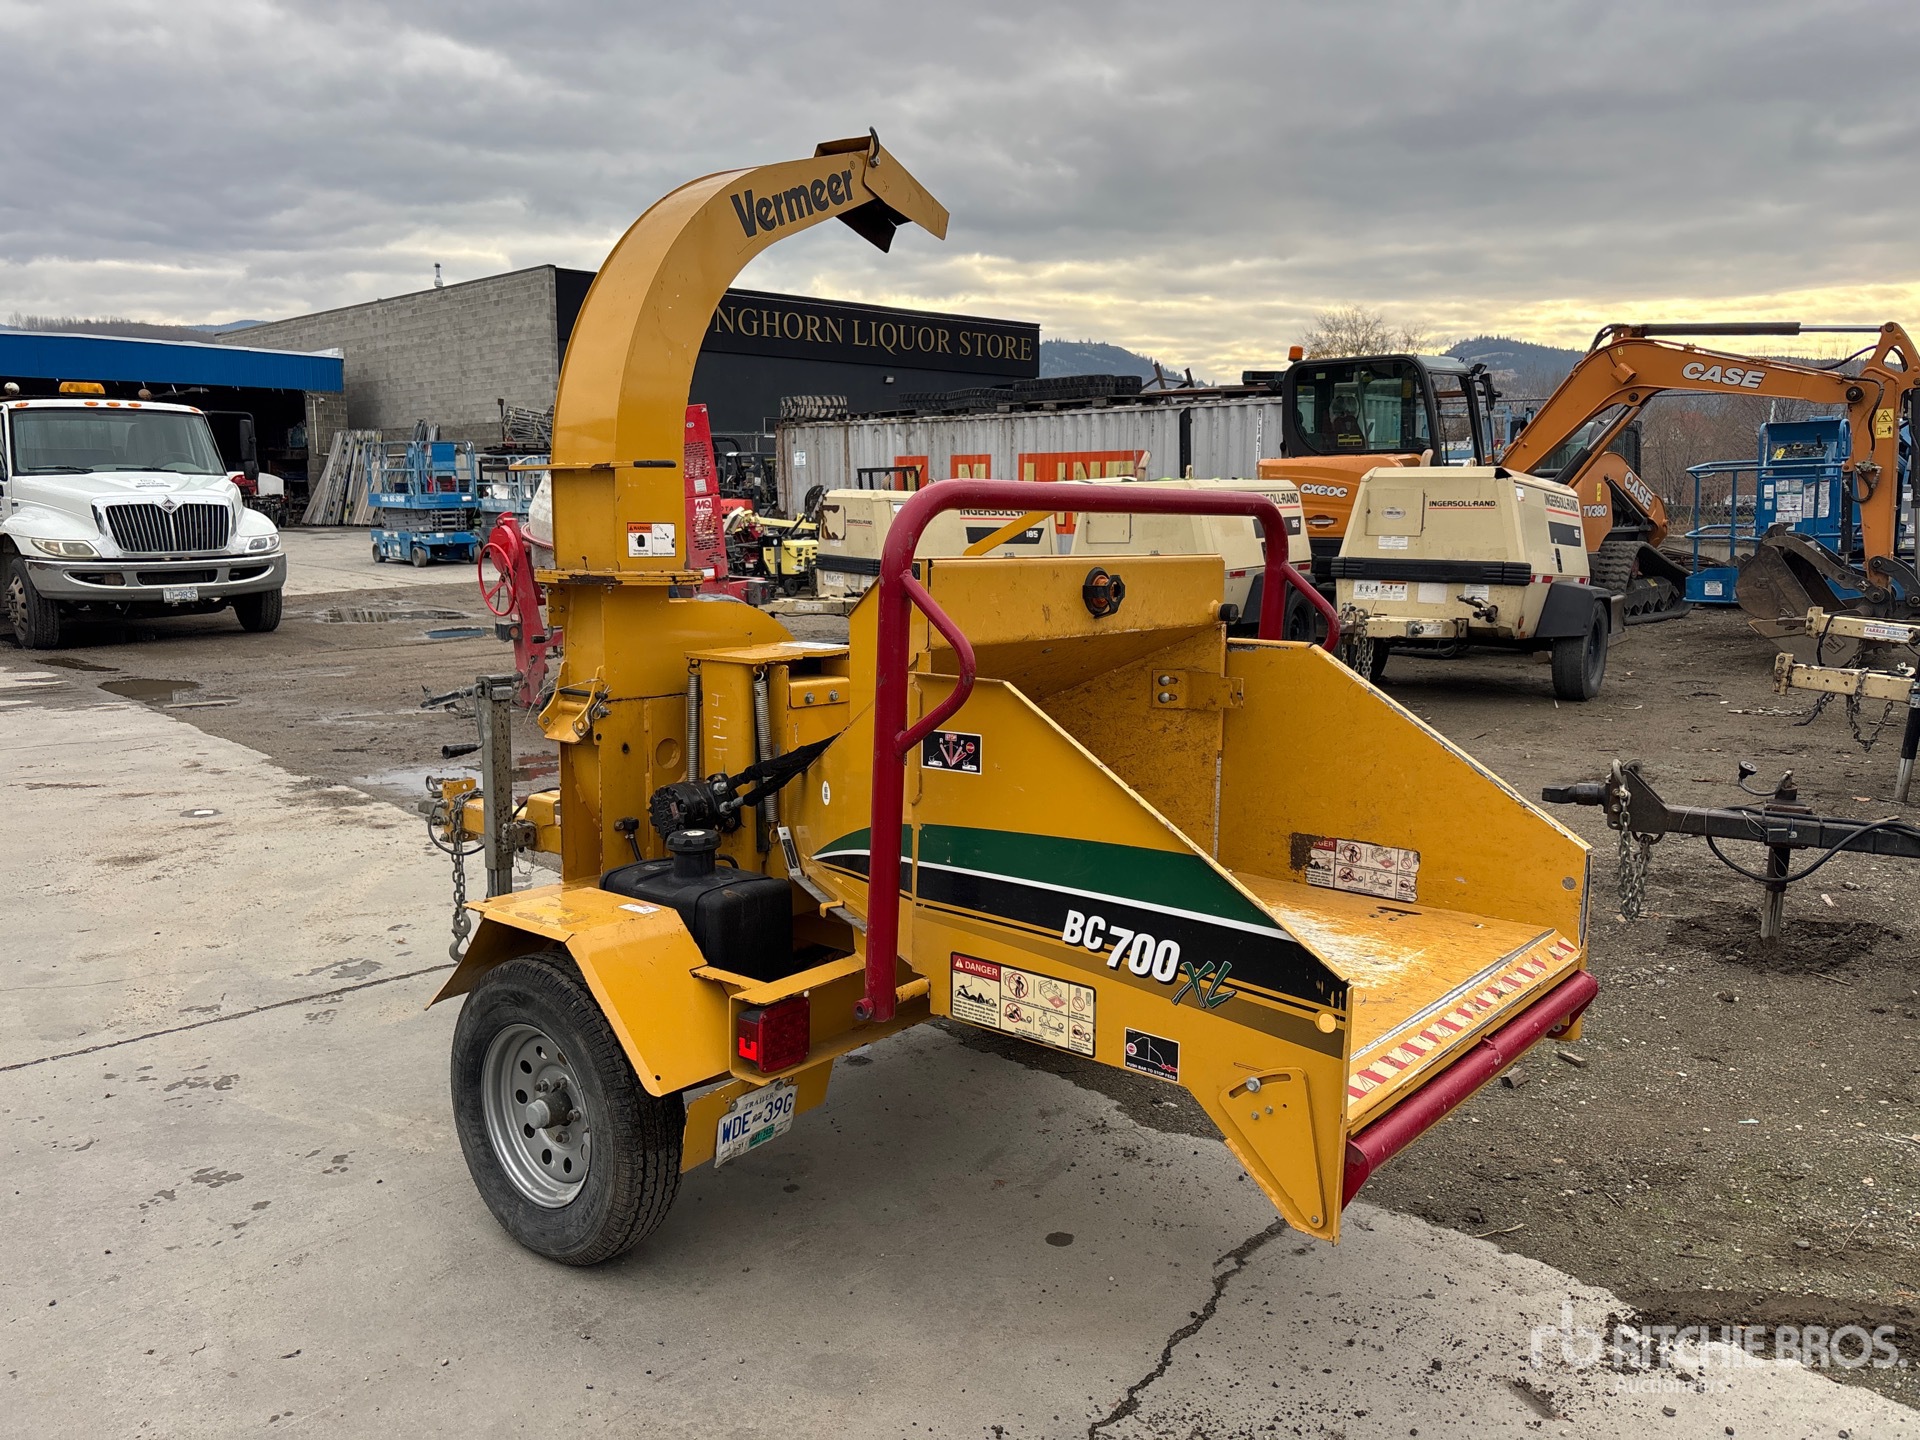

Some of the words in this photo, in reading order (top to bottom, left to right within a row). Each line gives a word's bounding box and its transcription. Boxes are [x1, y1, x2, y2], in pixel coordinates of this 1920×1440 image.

[730, 169, 854, 238] Vermeer
[714, 306, 844, 343] NGHORN
[853, 319, 952, 355] LIQUOR
[959, 331, 1032, 361] STORE
[1682, 362, 1766, 389] CASE
[1624, 471, 1653, 510] CASE
[1583, 505, 1607, 518] TV380
[1026, 530, 1039, 538] 185
[965, 961, 998, 976] DANGER
[1171, 960, 1237, 1009] XL
[744, 1092, 774, 1110] TRAILER
[722, 1110, 752, 1144] WDE
[763, 1092, 793, 1123] 39G
